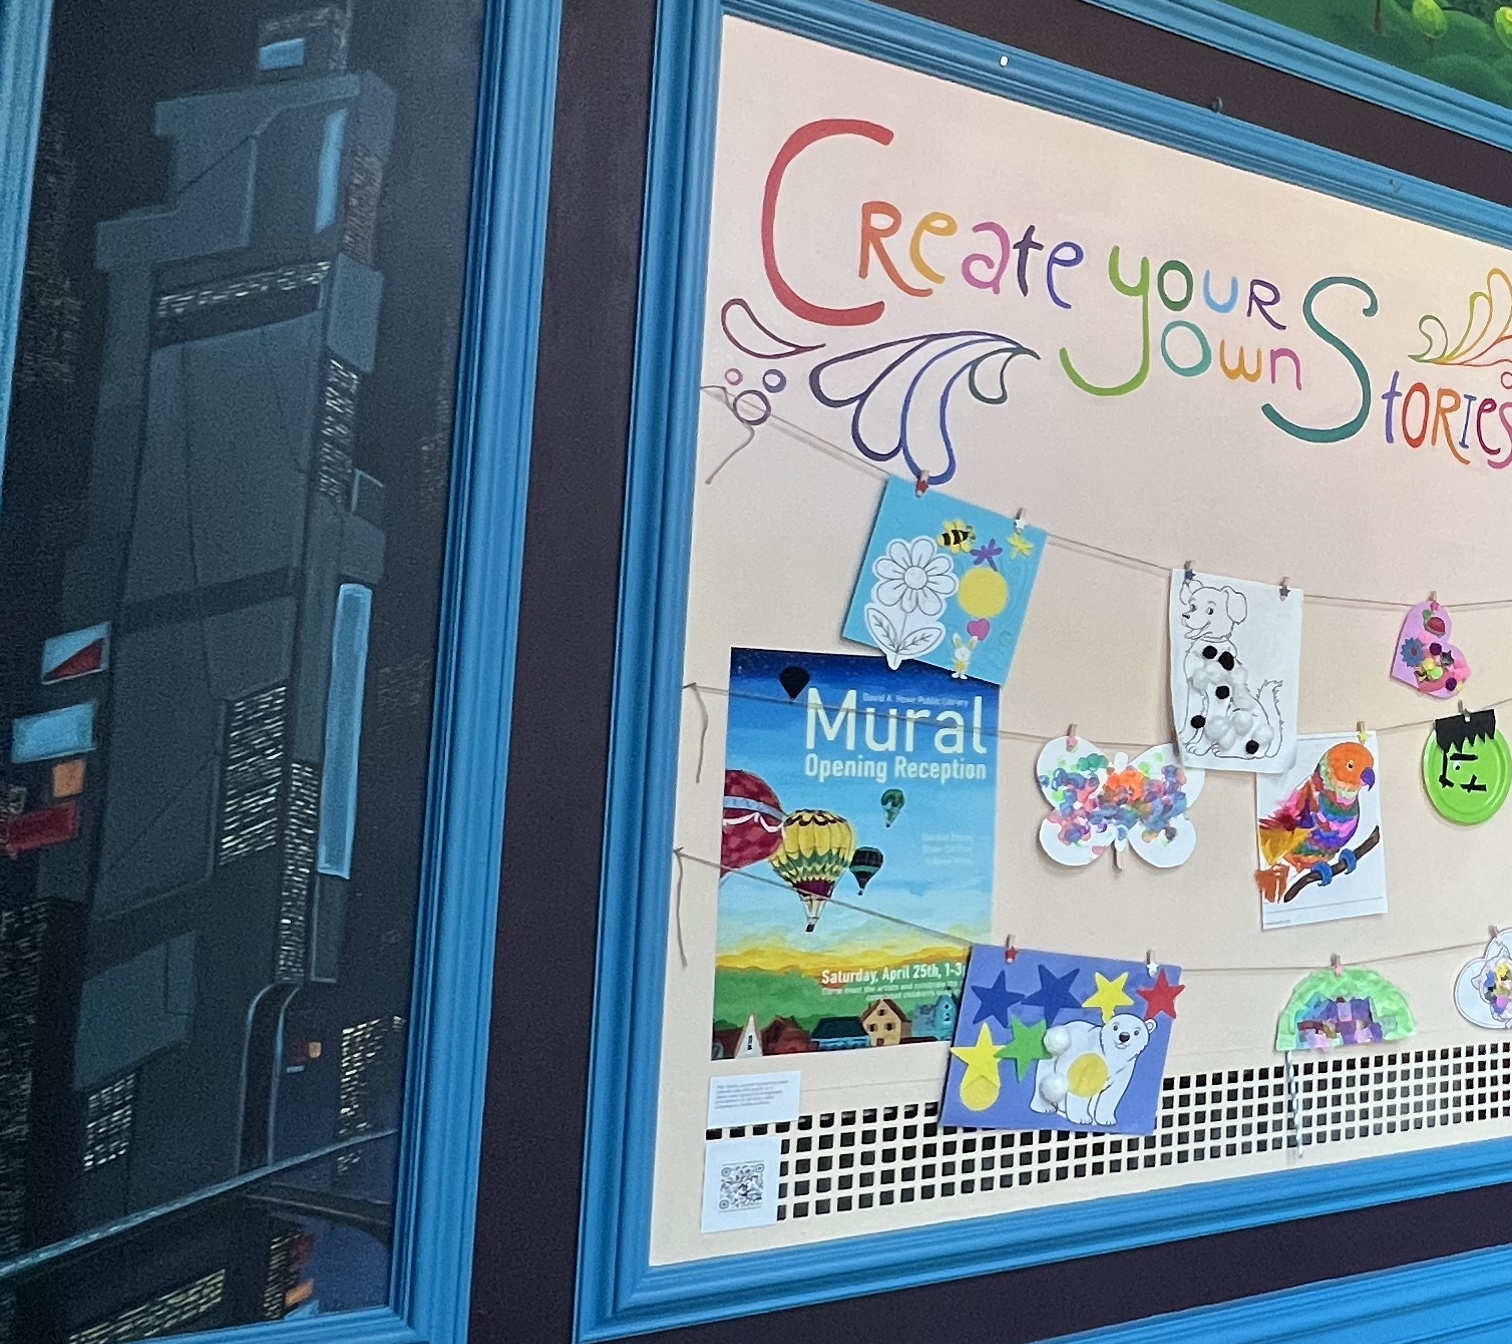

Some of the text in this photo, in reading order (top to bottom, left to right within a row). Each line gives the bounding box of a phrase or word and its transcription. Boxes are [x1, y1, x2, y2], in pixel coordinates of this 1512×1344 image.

[806, 687, 987, 754] Mural
[805, 753, 987, 785] Opening Reception
[821, 968, 879, 985] Saturday,
[881, 966, 910, 983] April
[912, 964, 942, 979] 25th,
